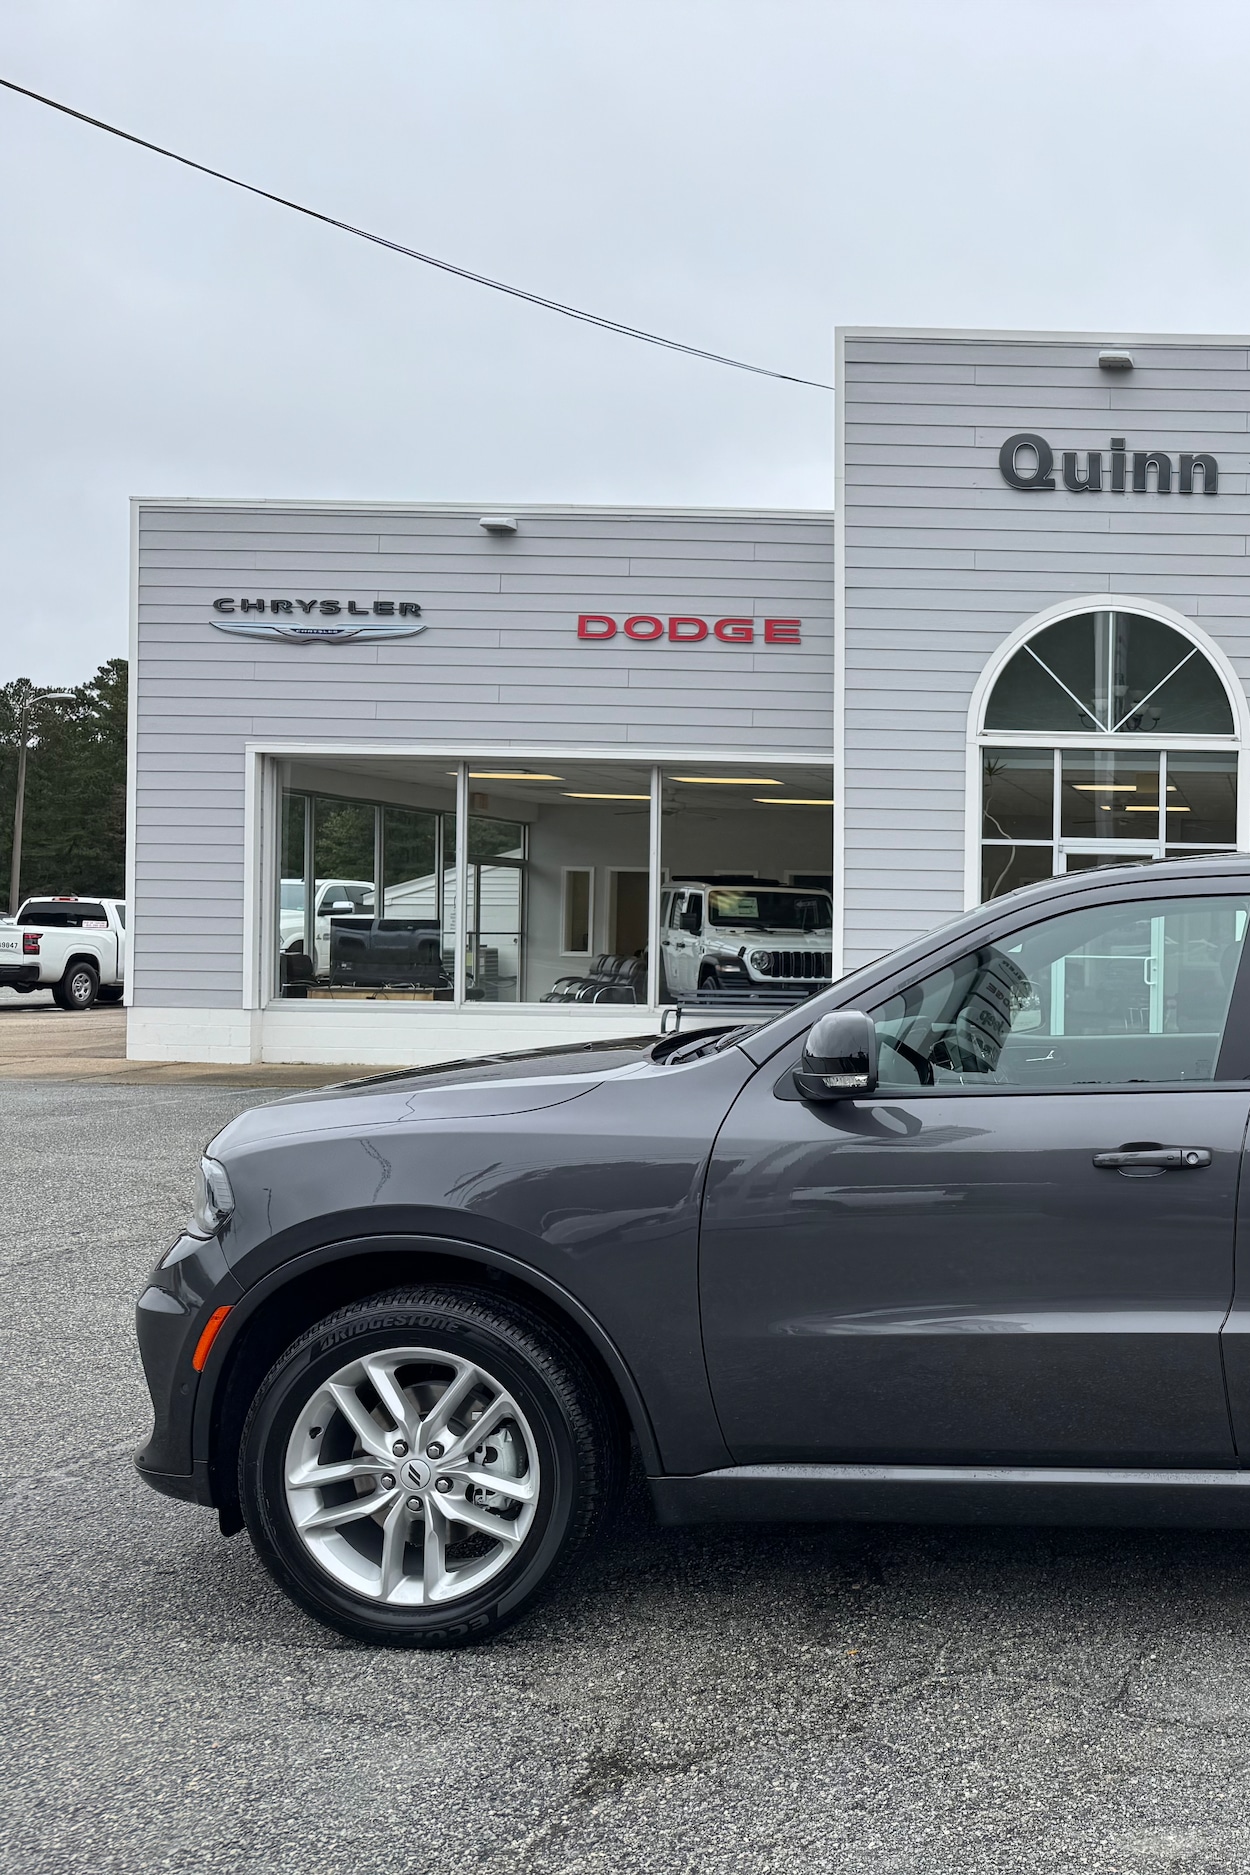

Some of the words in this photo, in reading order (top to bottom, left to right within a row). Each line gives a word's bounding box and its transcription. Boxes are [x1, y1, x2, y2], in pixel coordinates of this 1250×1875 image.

[998, 433, 1219, 495] Quinn
[212, 597, 423, 617] CHRYSLER
[577, 614, 802, 645] DODGE
[320, 1313, 463, 1351] BRIDGESTONE
